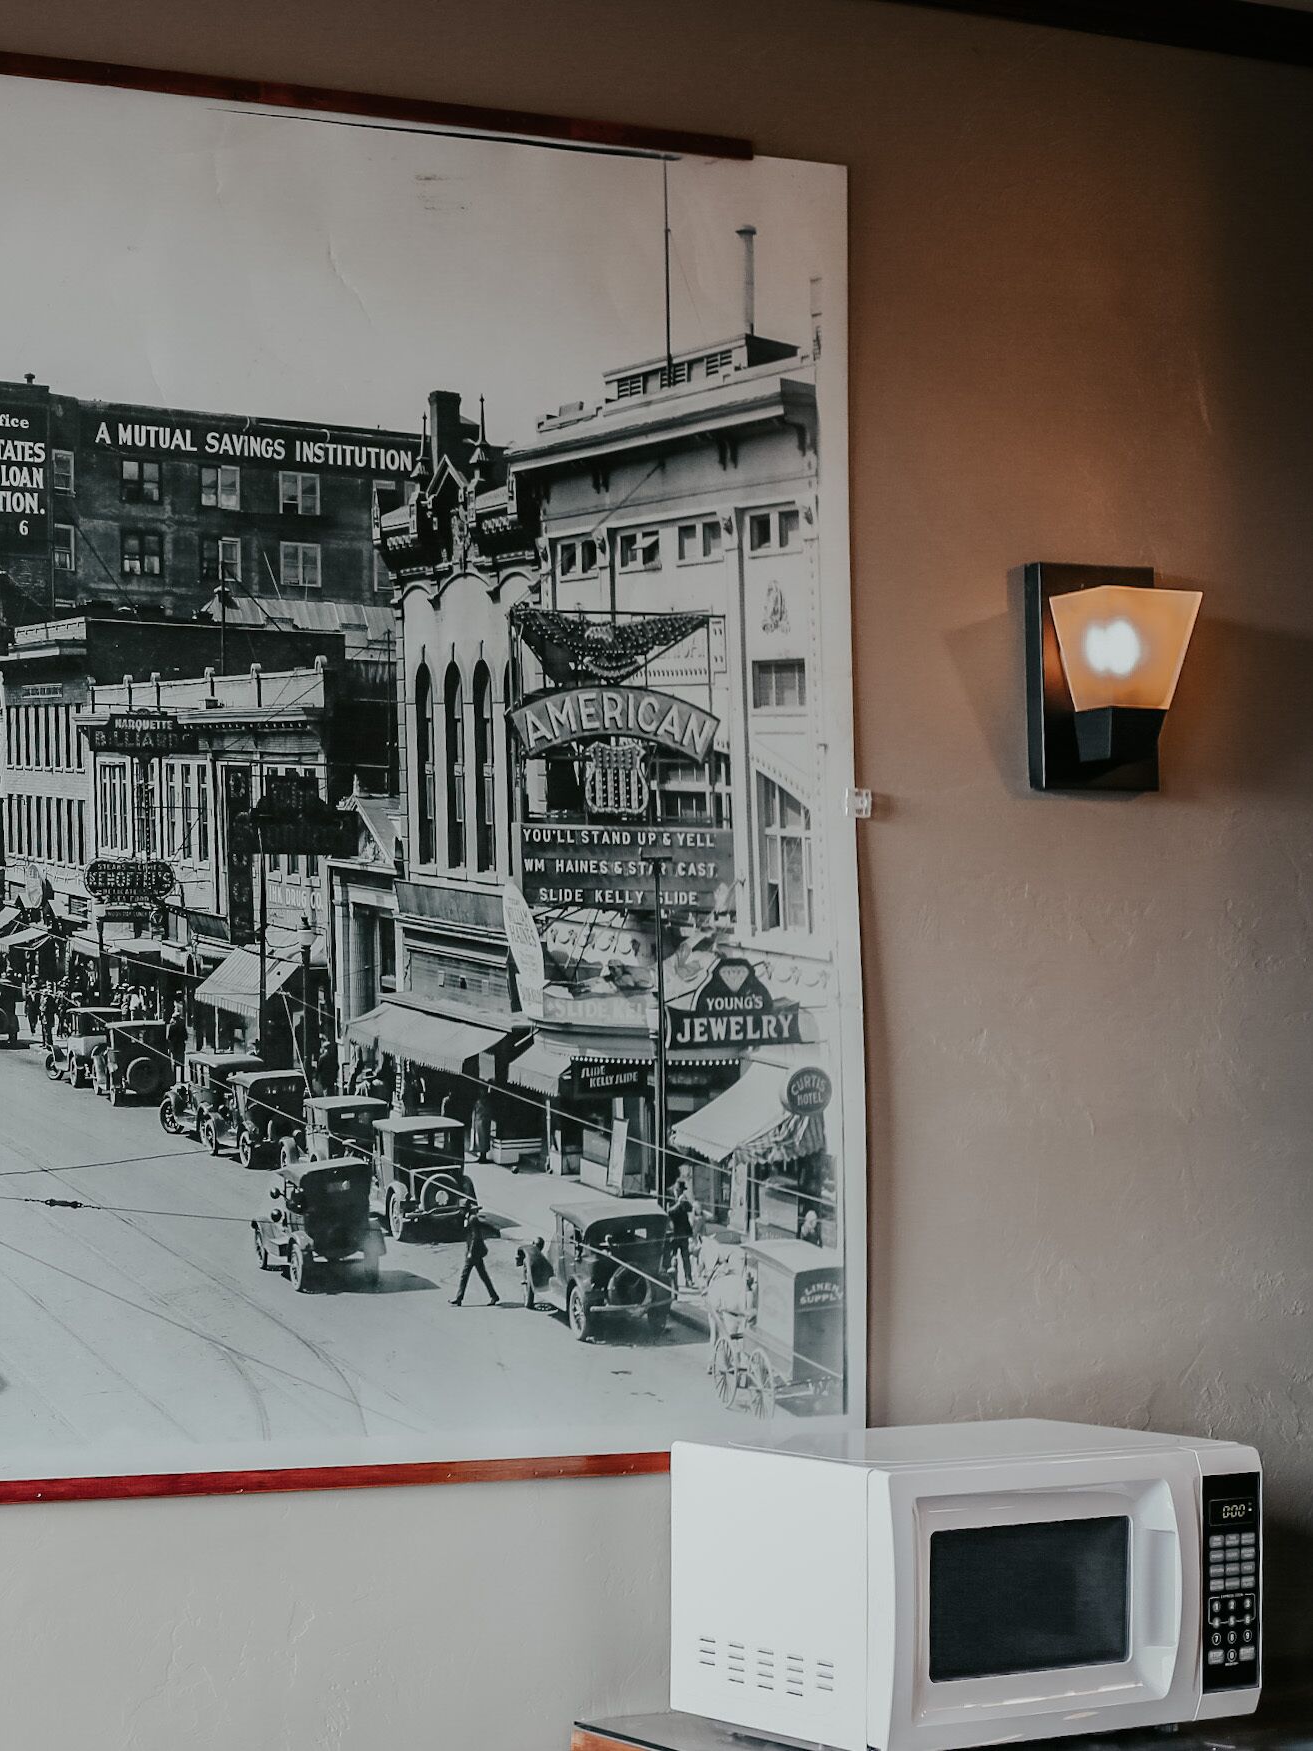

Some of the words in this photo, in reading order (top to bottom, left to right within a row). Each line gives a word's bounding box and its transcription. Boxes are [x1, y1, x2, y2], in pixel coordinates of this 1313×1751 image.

[95, 422, 111, 444] A
[118, 423, 197, 452] MUTUAL
[204, 431, 286, 460] SAVINGS
[295, 440, 413, 471] INSTITUTION
[0, 464, 44, 489] LOAN
[19, 520, 29, 535] 6
[525, 691, 711, 755] AMERICAN
[522, 829, 575, 843] YOU'LL
[581, 830, 631, 845] STAND
[637, 832, 656, 846] UP
[662, 833, 671, 846] &
[676, 833, 715, 847] YELL
[524, 858, 545, 872] WM
[555, 859, 608, 874] HAINES
[613, 861, 623, 874] &
[539, 887, 583, 902] SLIDE
[594, 889, 644, 904] KELLY
[706, 993, 763, 1011] YOUNG'S
[675, 1014, 793, 1043] JEWELRY
[581, 1065, 605, 1079] SLIDE
[589, 1075, 615, 1088] KELLY
[614, 1071, 638, 1084] SLIDE
[791, 1074, 826, 1096] CURTIS
[797, 1091, 823, 1106] HOTEL
